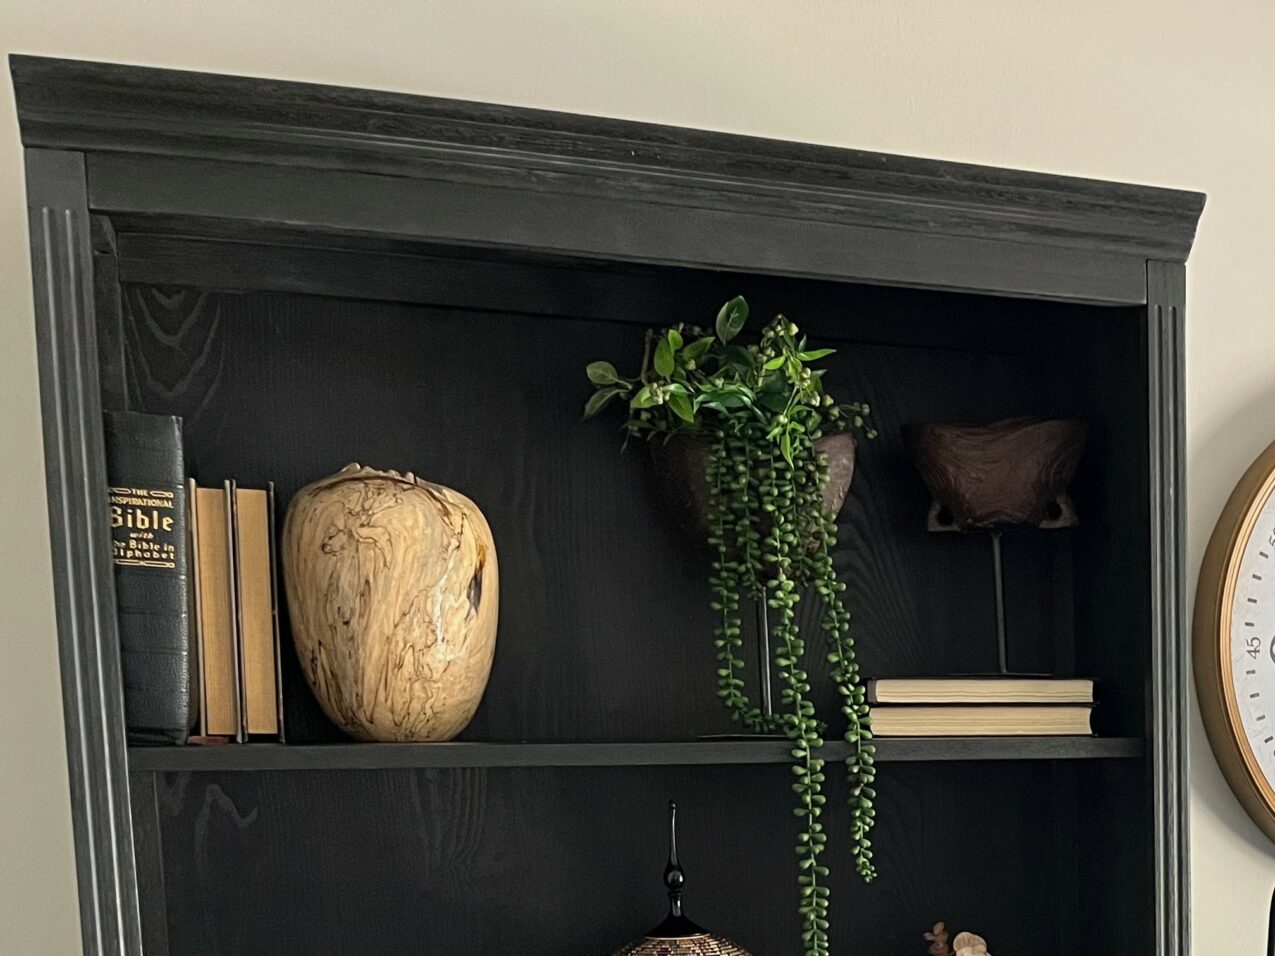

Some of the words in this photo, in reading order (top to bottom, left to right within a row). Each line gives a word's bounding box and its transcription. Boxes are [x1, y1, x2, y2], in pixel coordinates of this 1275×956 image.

[131, 488, 149, 497] THE
[112, 496, 175, 509] NSPIRATIONAL
[111, 506, 174, 532] Bible
[129, 539, 161, 551] Bible
[163, 542, 175, 552] in
[1245, 637, 1262, 660] 45
